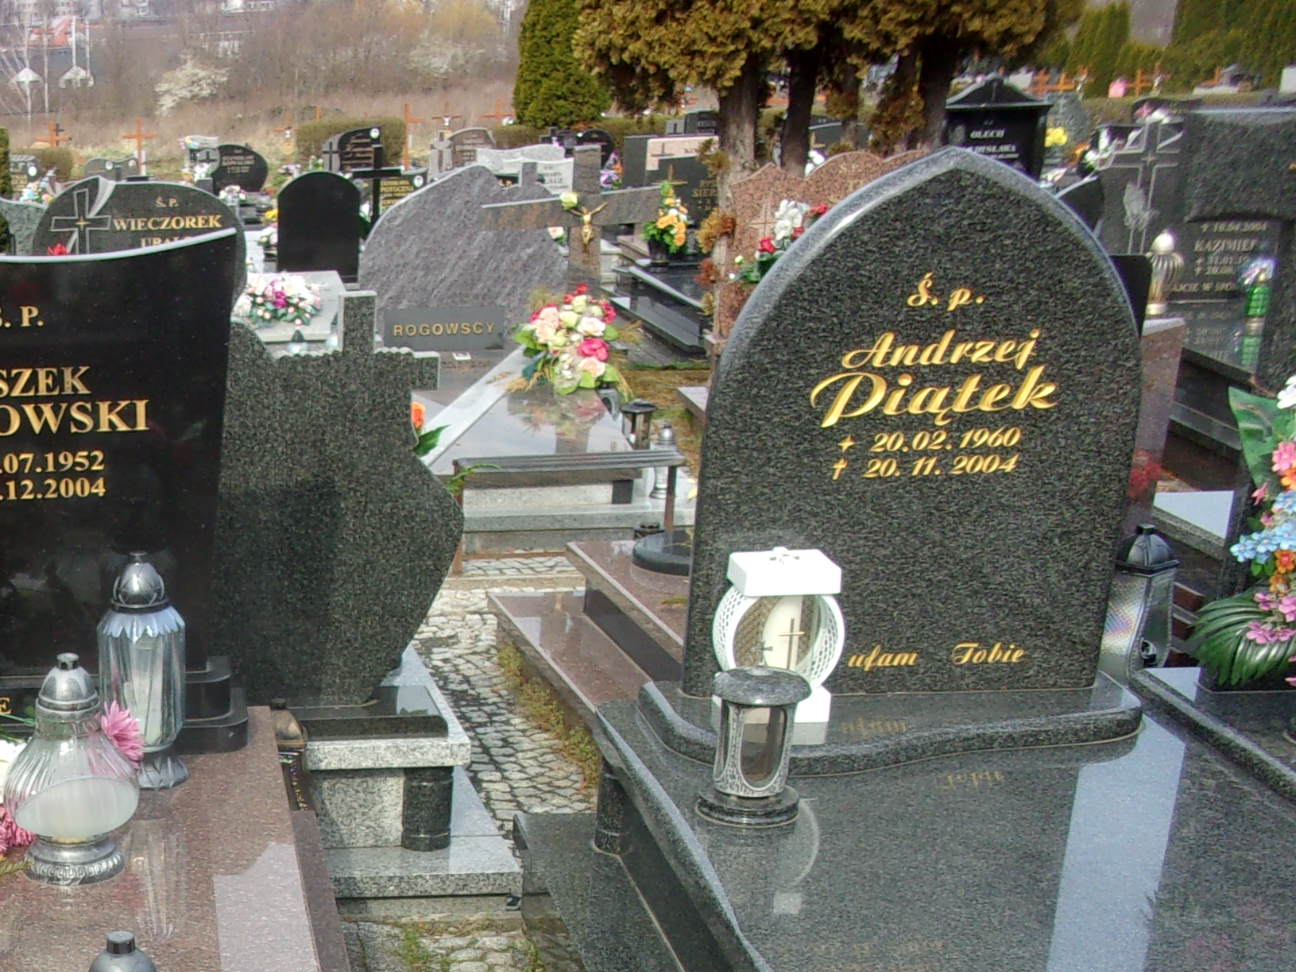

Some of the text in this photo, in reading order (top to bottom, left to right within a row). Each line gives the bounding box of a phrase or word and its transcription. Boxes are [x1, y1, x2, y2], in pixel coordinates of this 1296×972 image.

[113, 214, 222, 231] WIECZOREK
[20, 305, 45, 328] P.
[393, 322, 496, 337] ROGOWSCY
[841, 328, 1042, 370] Andrzej
[810, 365, 1058, 428] Piątek
[951, 642, 1026, 666] Tobie
